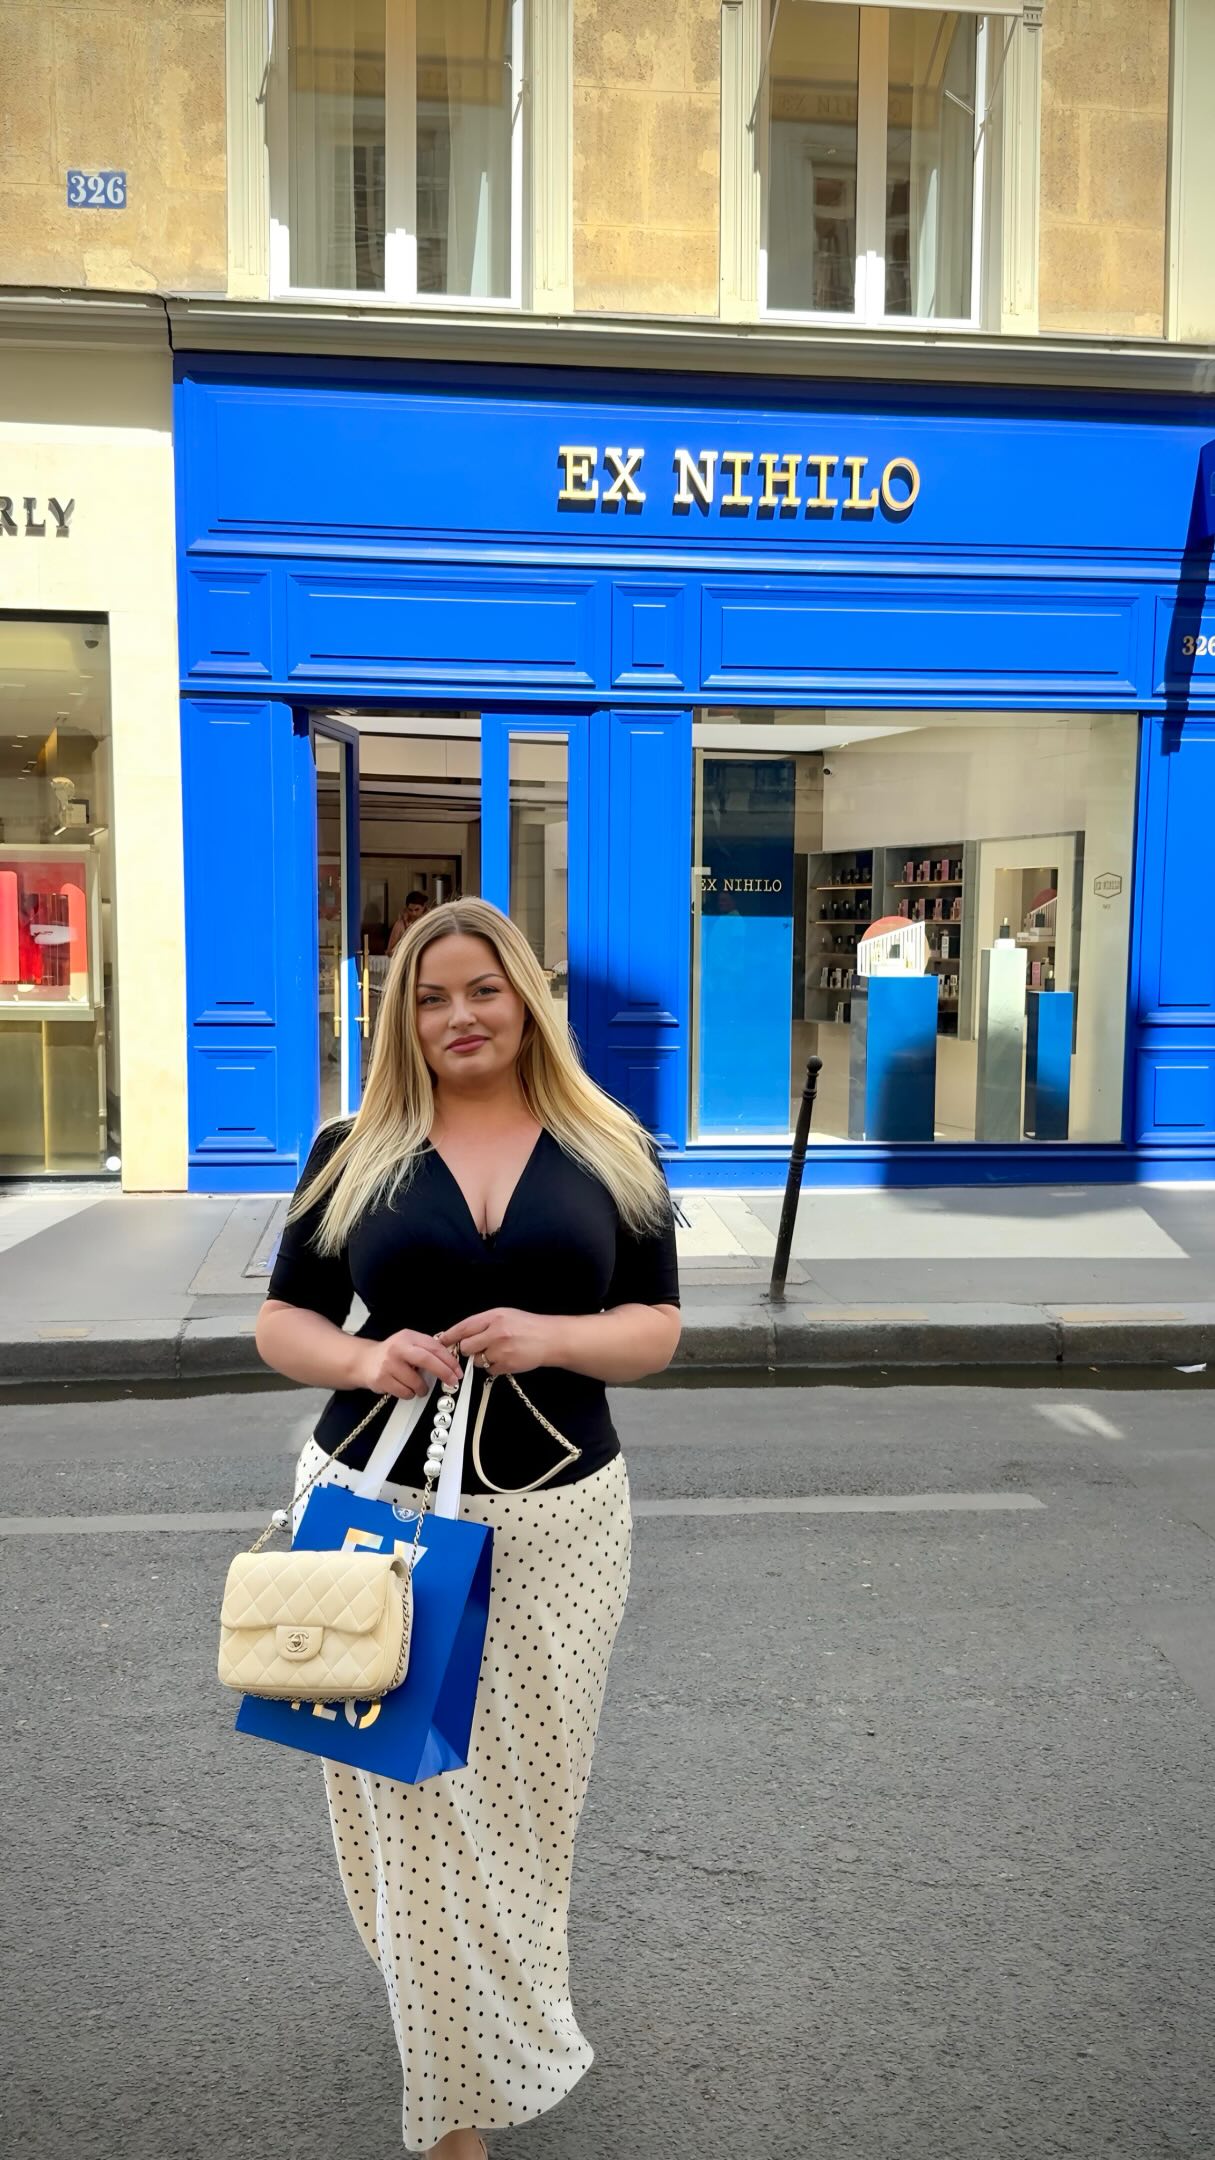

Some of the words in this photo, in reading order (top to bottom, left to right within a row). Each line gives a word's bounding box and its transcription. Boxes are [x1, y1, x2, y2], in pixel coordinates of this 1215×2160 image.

[70, 175, 124, 204] 326
[558, 445, 646, 502] EX
[673, 449, 921, 512] NIHILO
[0, 495, 75, 531] RLY
[723, 878, 782, 892] NIHILO
